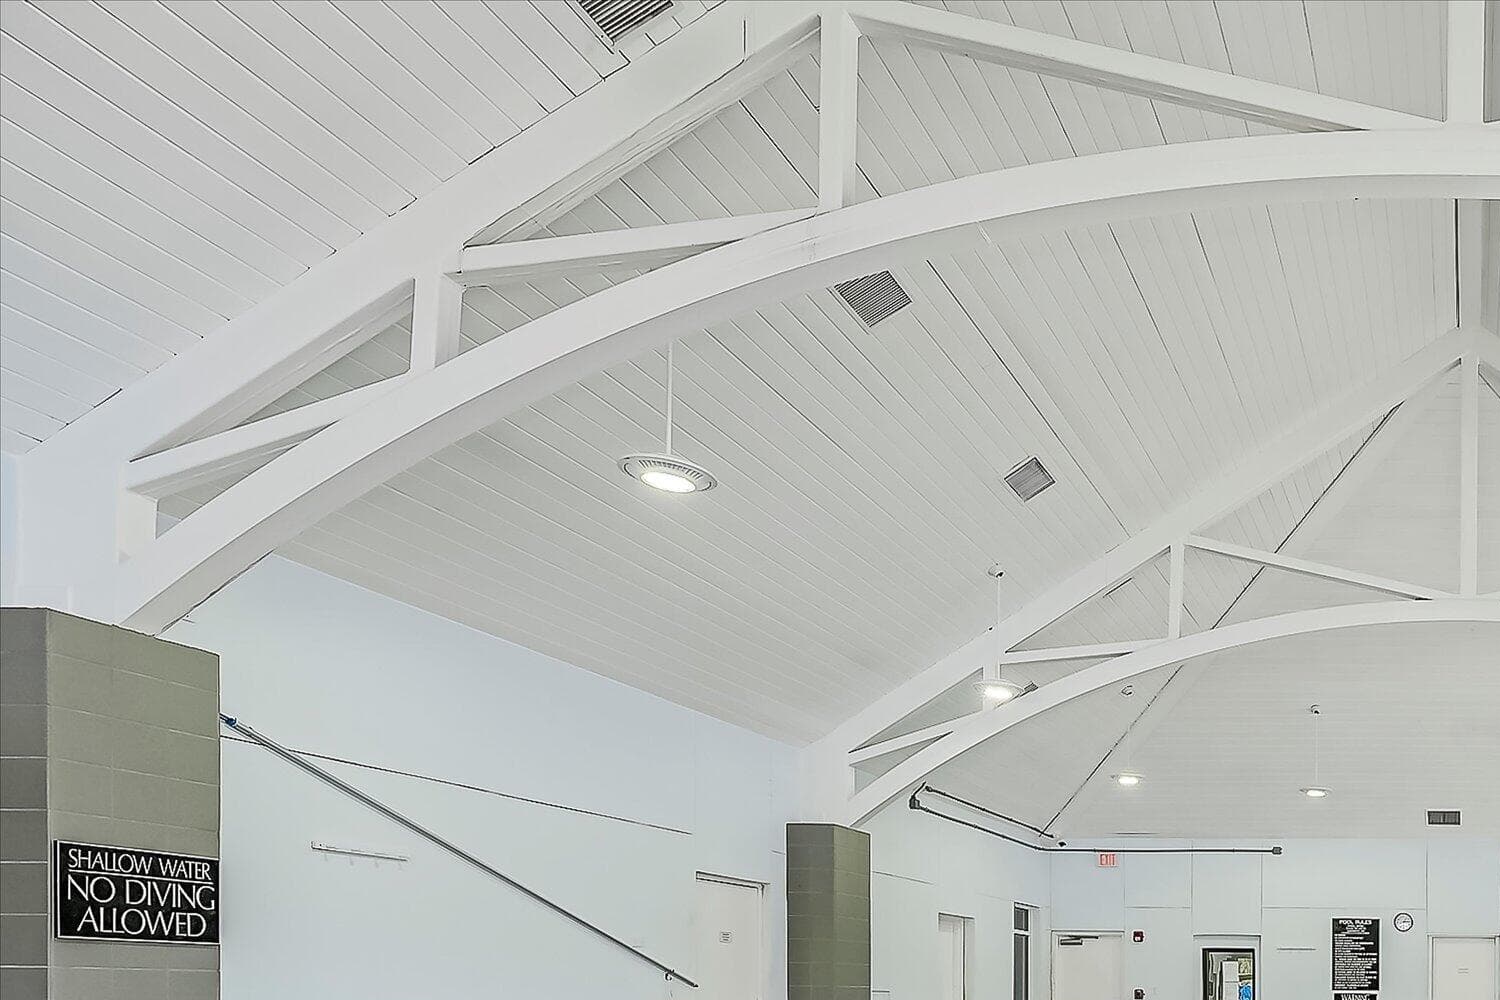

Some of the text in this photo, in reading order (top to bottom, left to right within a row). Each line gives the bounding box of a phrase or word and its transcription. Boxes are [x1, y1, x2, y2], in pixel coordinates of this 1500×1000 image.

[67, 848, 212, 881] SHALLOW WATER
[1100, 854, 1115, 865] EXIT
[67, 874, 216, 911] NO DIVING
[76, 906, 207, 937] ALLOWED
